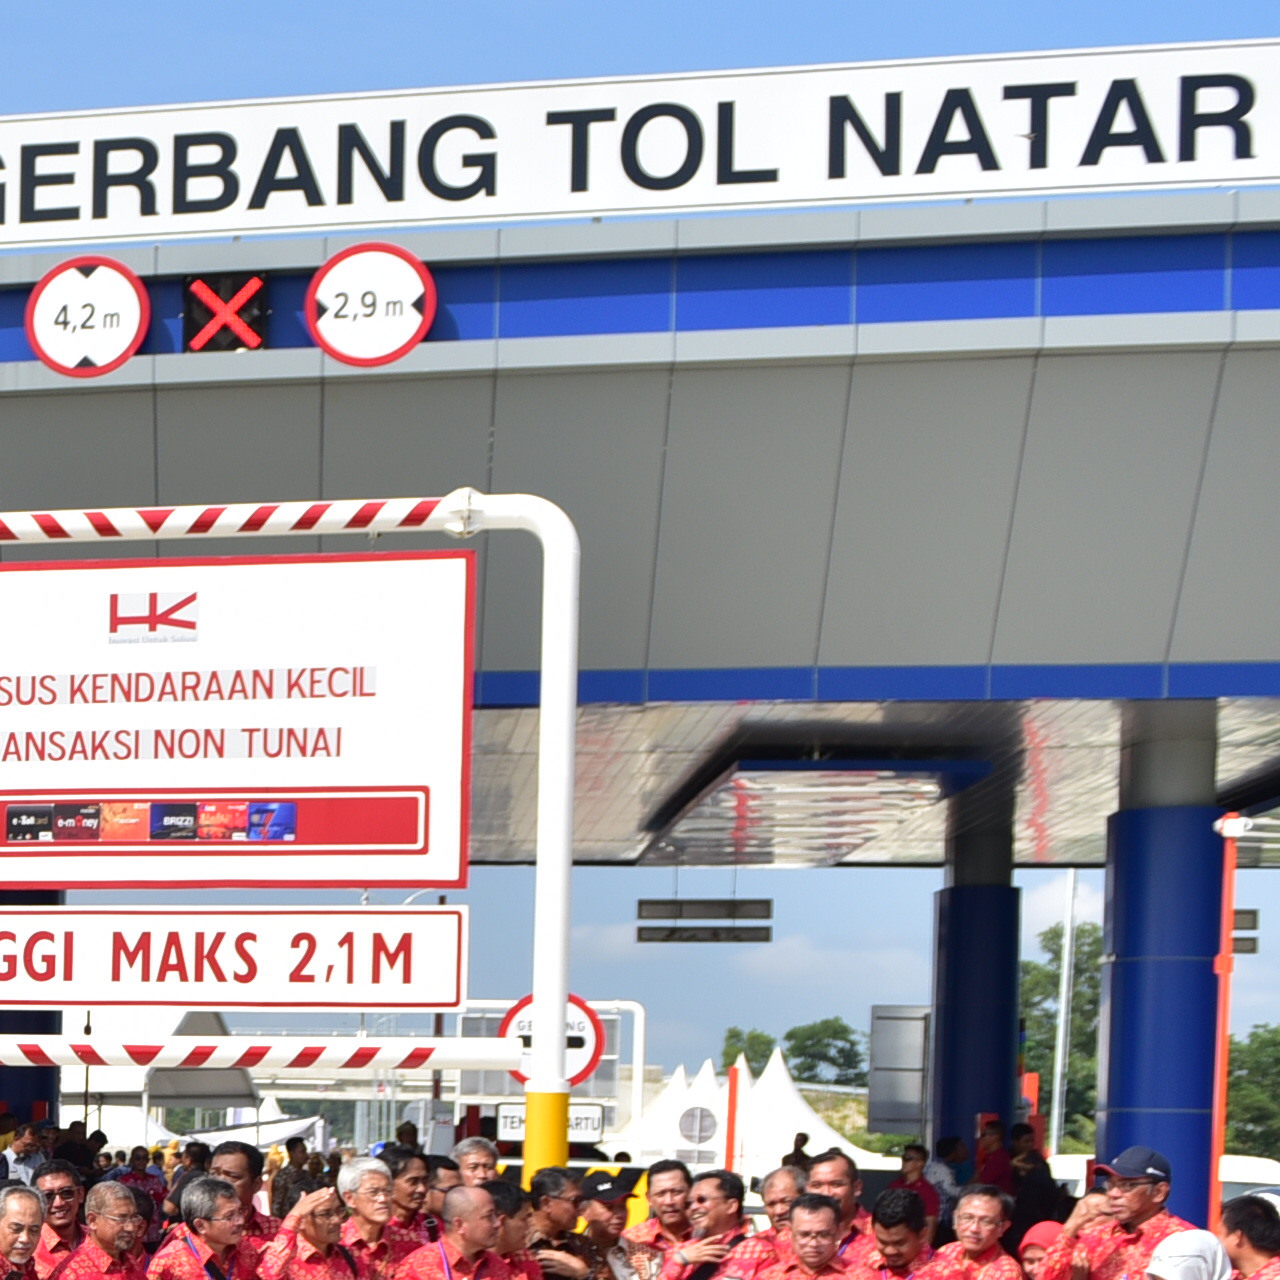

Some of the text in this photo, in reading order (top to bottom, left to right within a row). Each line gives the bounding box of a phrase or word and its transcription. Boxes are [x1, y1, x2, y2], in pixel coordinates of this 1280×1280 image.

[546, 101, 779, 193] TOL
[828, 73, 1257, 180] NATAR
[54, 303, 120, 333] 4,2 m
[333, 291, 404, 320] 2,9 m
[69, 669, 275, 704] KENDARAAN
[287, 666, 376, 699] KECIL
[154, 728, 226, 759] NON
[242, 727, 342, 759] TUNAI
[111, 931, 258, 984] MAKS
